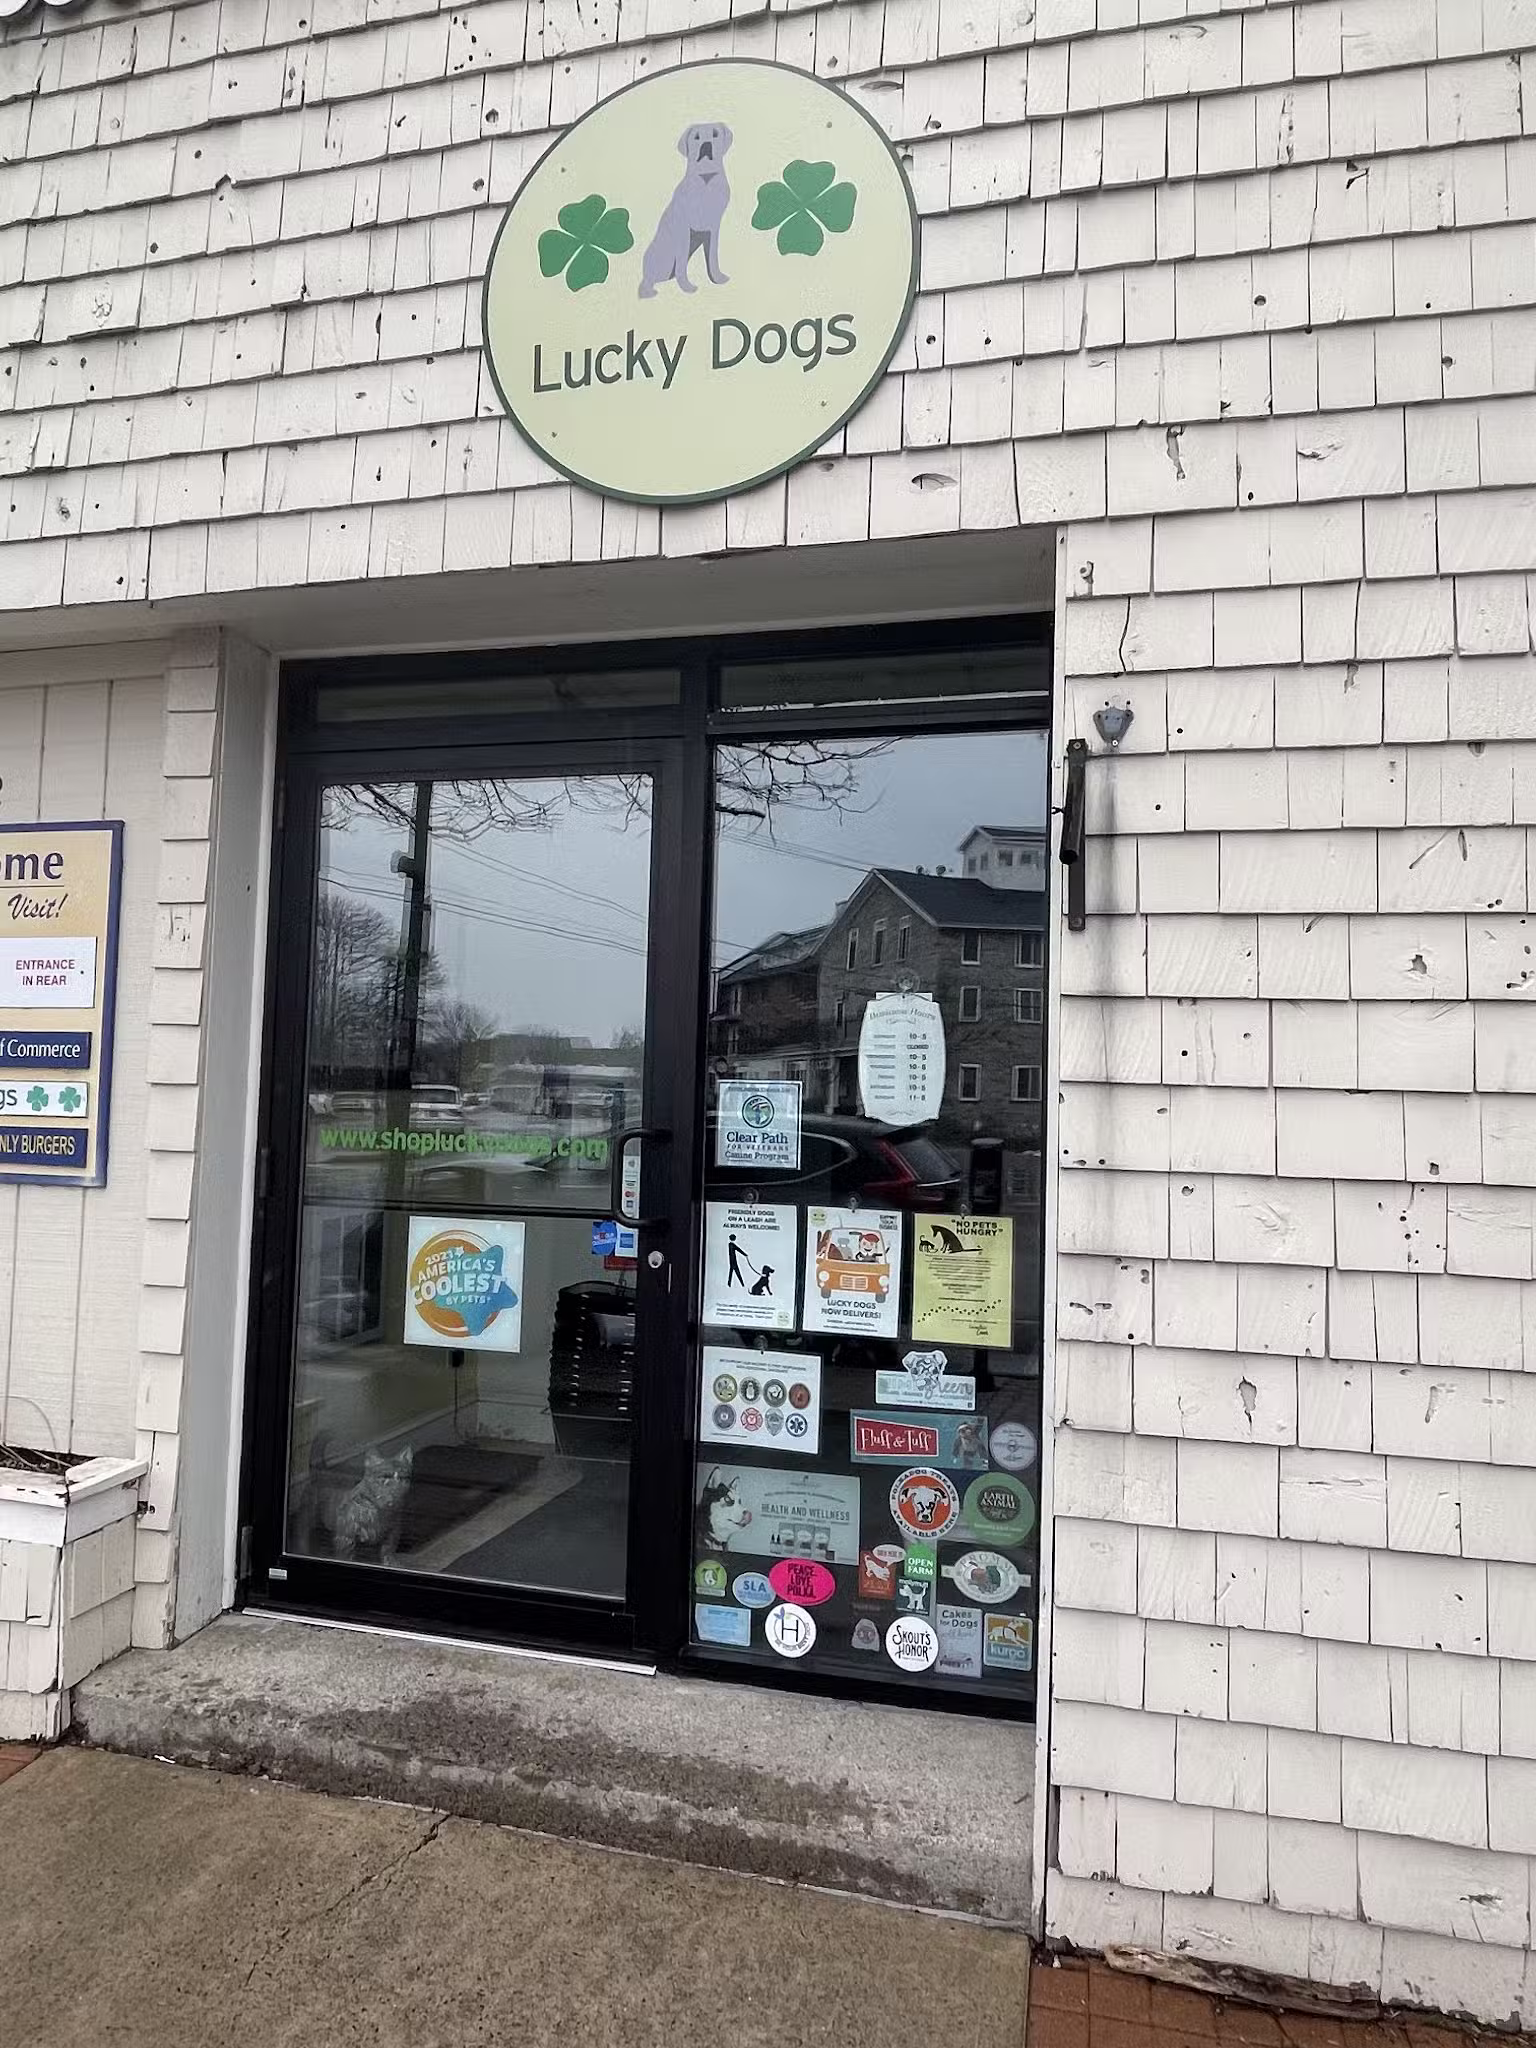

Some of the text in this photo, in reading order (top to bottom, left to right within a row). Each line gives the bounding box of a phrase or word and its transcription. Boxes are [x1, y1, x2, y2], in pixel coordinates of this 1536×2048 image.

[533, 313, 857, 393] Lucky Dogs
[8, 893, 69, 920] Visit!
[16, 959, 75, 970] ENTRANCE
[23, 975, 67, 986] IN REAR
[7, 1038, 81, 1058] Commerce
[726, 1131, 788, 1144] Clear Path
[21, 1134, 76, 1156] BURGERS
[746, 1144, 789, 1152] VETERANS
[725, 1151, 753, 1160] Canine
[754, 1151, 790, 1162] Program
[972, 1220, 998, 1229] PETS
[418, 1258, 496, 1283] AMERICA'S
[411, 1274, 508, 1306] COOLEST
[827, 1299, 877, 1309] LUCKY DOGS
[821, 1307, 882, 1319] NOW DELIVERS!
[860, 1427, 932, 1452] Fluff & Tuff
[983, 1491, 1014, 1502] EARTH
[980, 1498, 1017, 1509] ANIMAL
[761, 1503, 790, 1515] HEALTH
[791, 1506, 807, 1517] AND
[808, 1508, 850, 1521] WELLNESS
[893, 1510, 938, 1537] AVAILABLE
[908, 1558, 934, 1567] OPEN
[908, 1565, 934, 1576] FARM
[743, 1580, 767, 1593] SLA
[942, 1610, 973, 1619] Cakes
[781, 1617, 799, 1643] H
[951, 1619, 979, 1630] Dogs
[892, 1624, 931, 1646] SKOUT'S
[894, 1643, 929, 1662] HONOR
[990, 1643, 1026, 1660] kurgo
